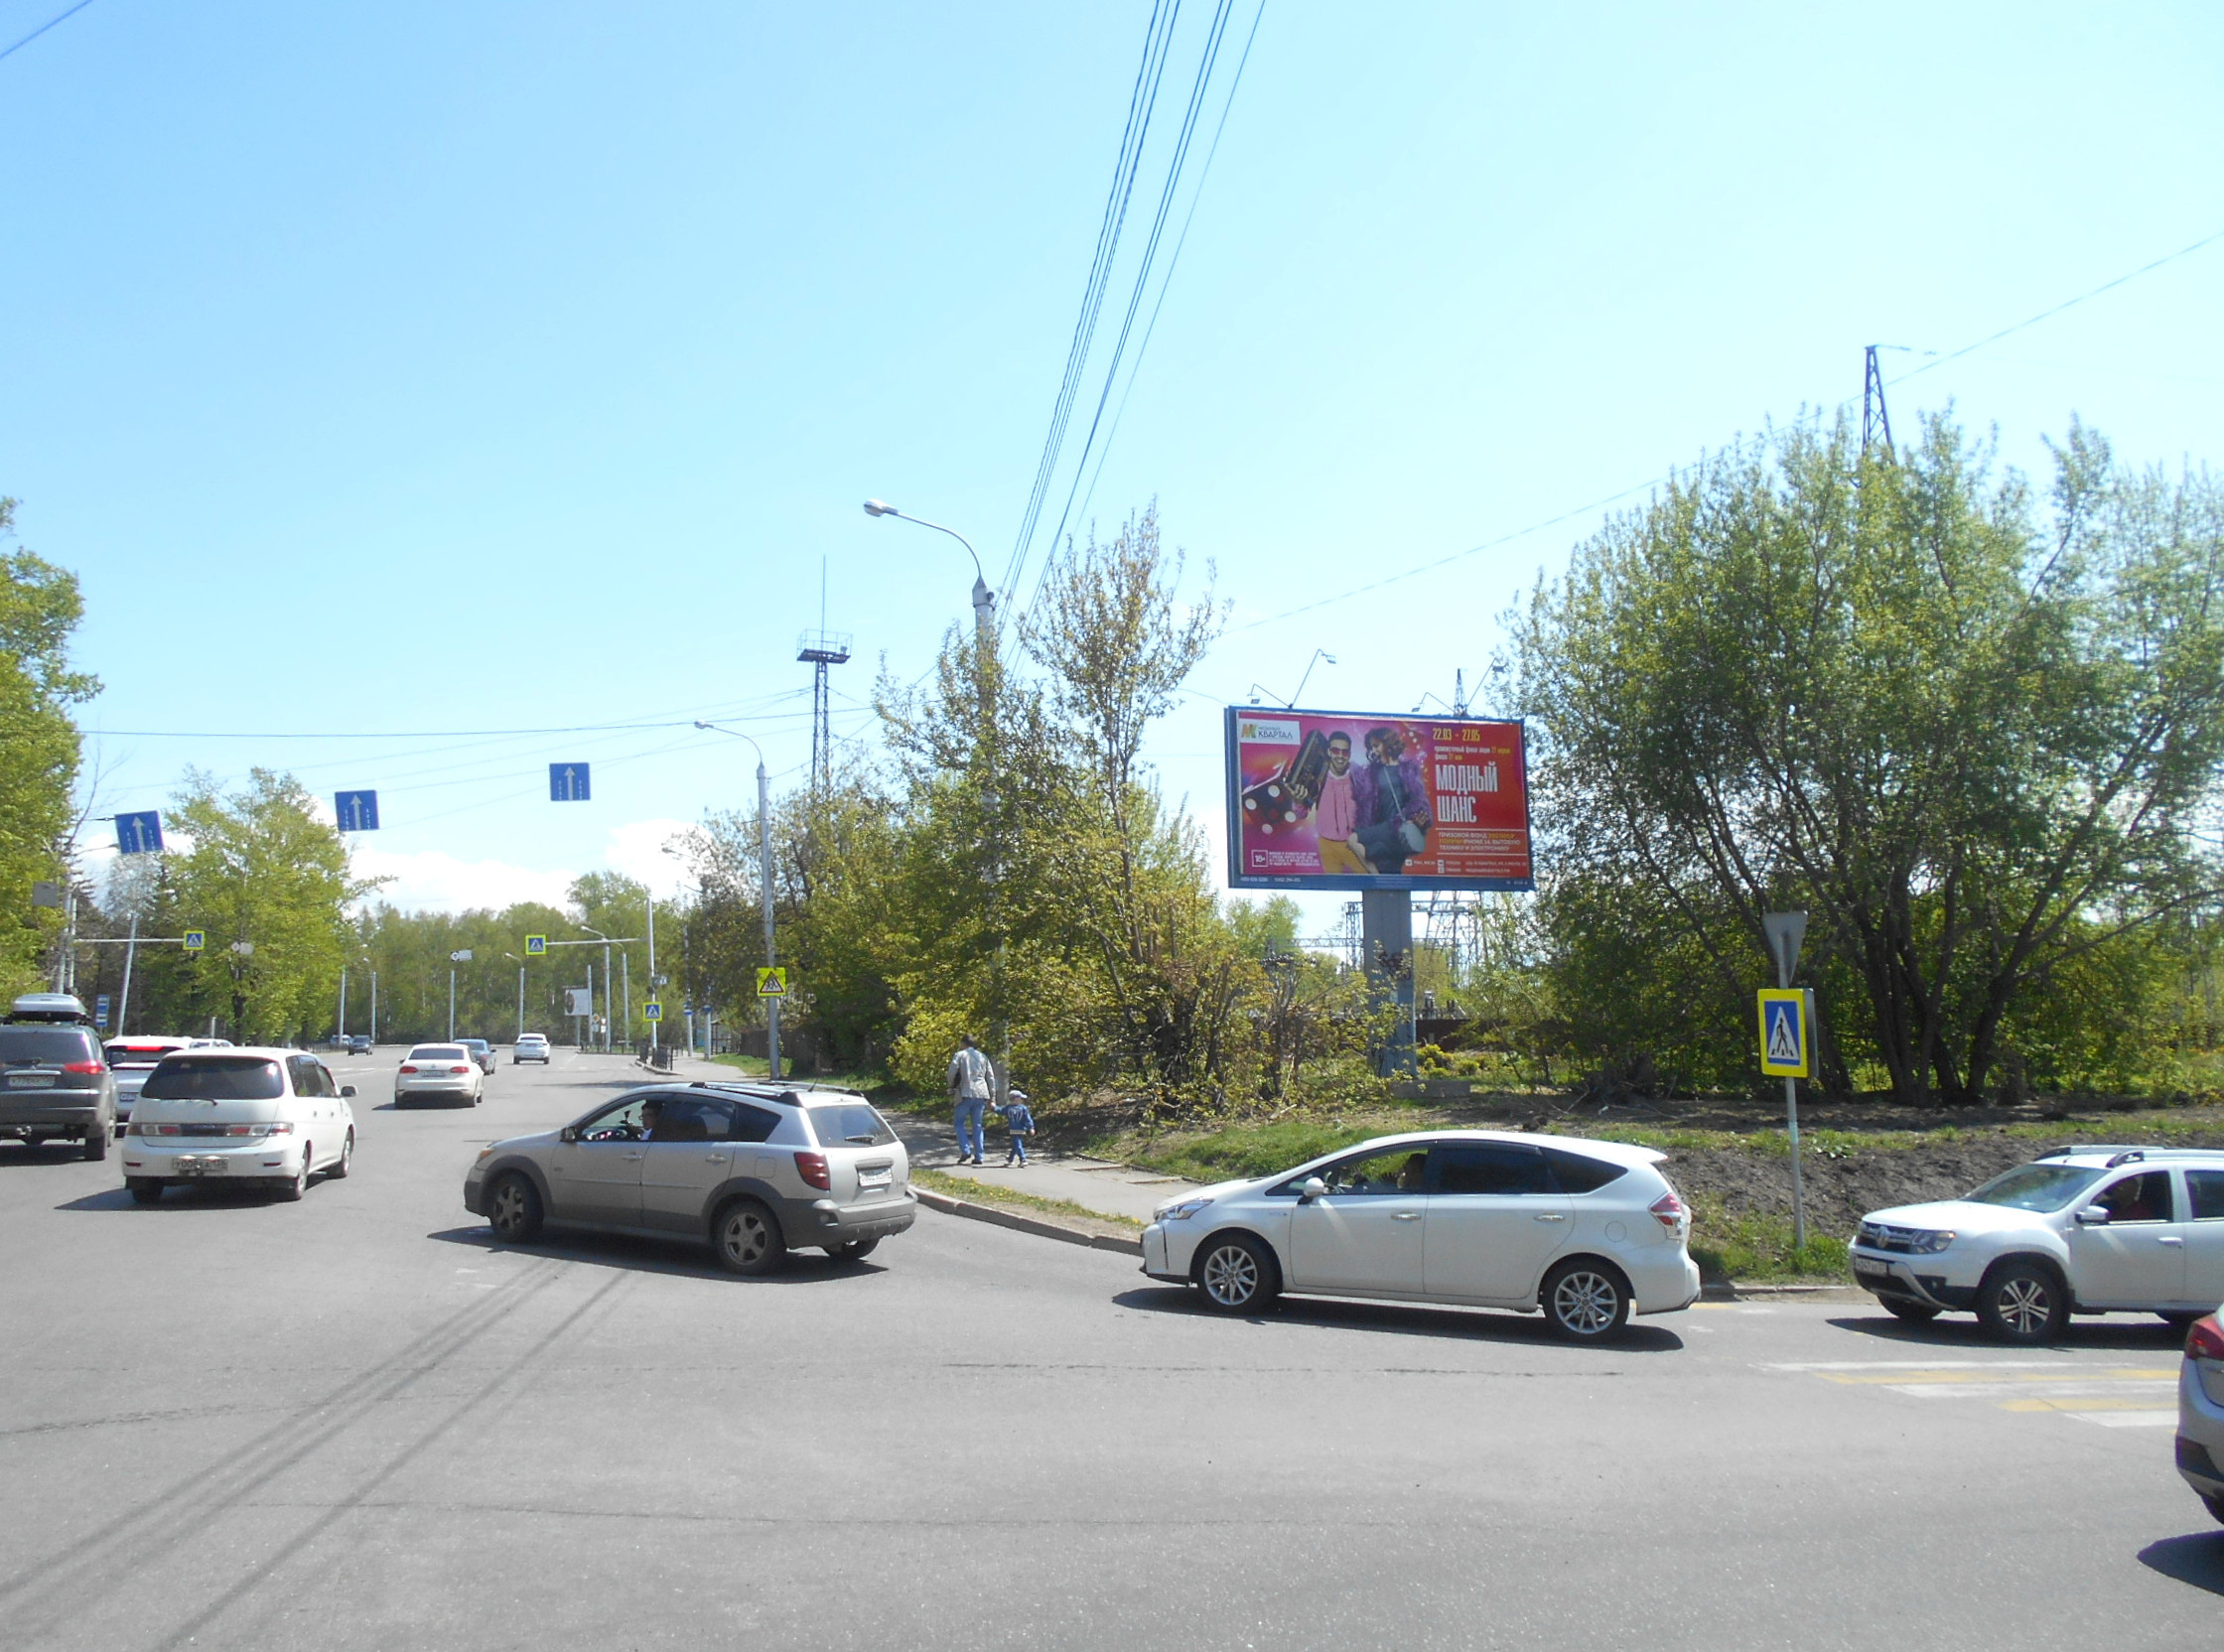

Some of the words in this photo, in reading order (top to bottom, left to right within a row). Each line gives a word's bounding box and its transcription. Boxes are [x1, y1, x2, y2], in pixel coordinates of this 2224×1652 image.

[1258, 730, 1293, 739] КВАРТАЛ
[1433, 728, 1453, 741] 22.03
[1435, 760, 1498, 795] МОДНЫЙ
[1437, 795, 1477, 823] ШАНС
